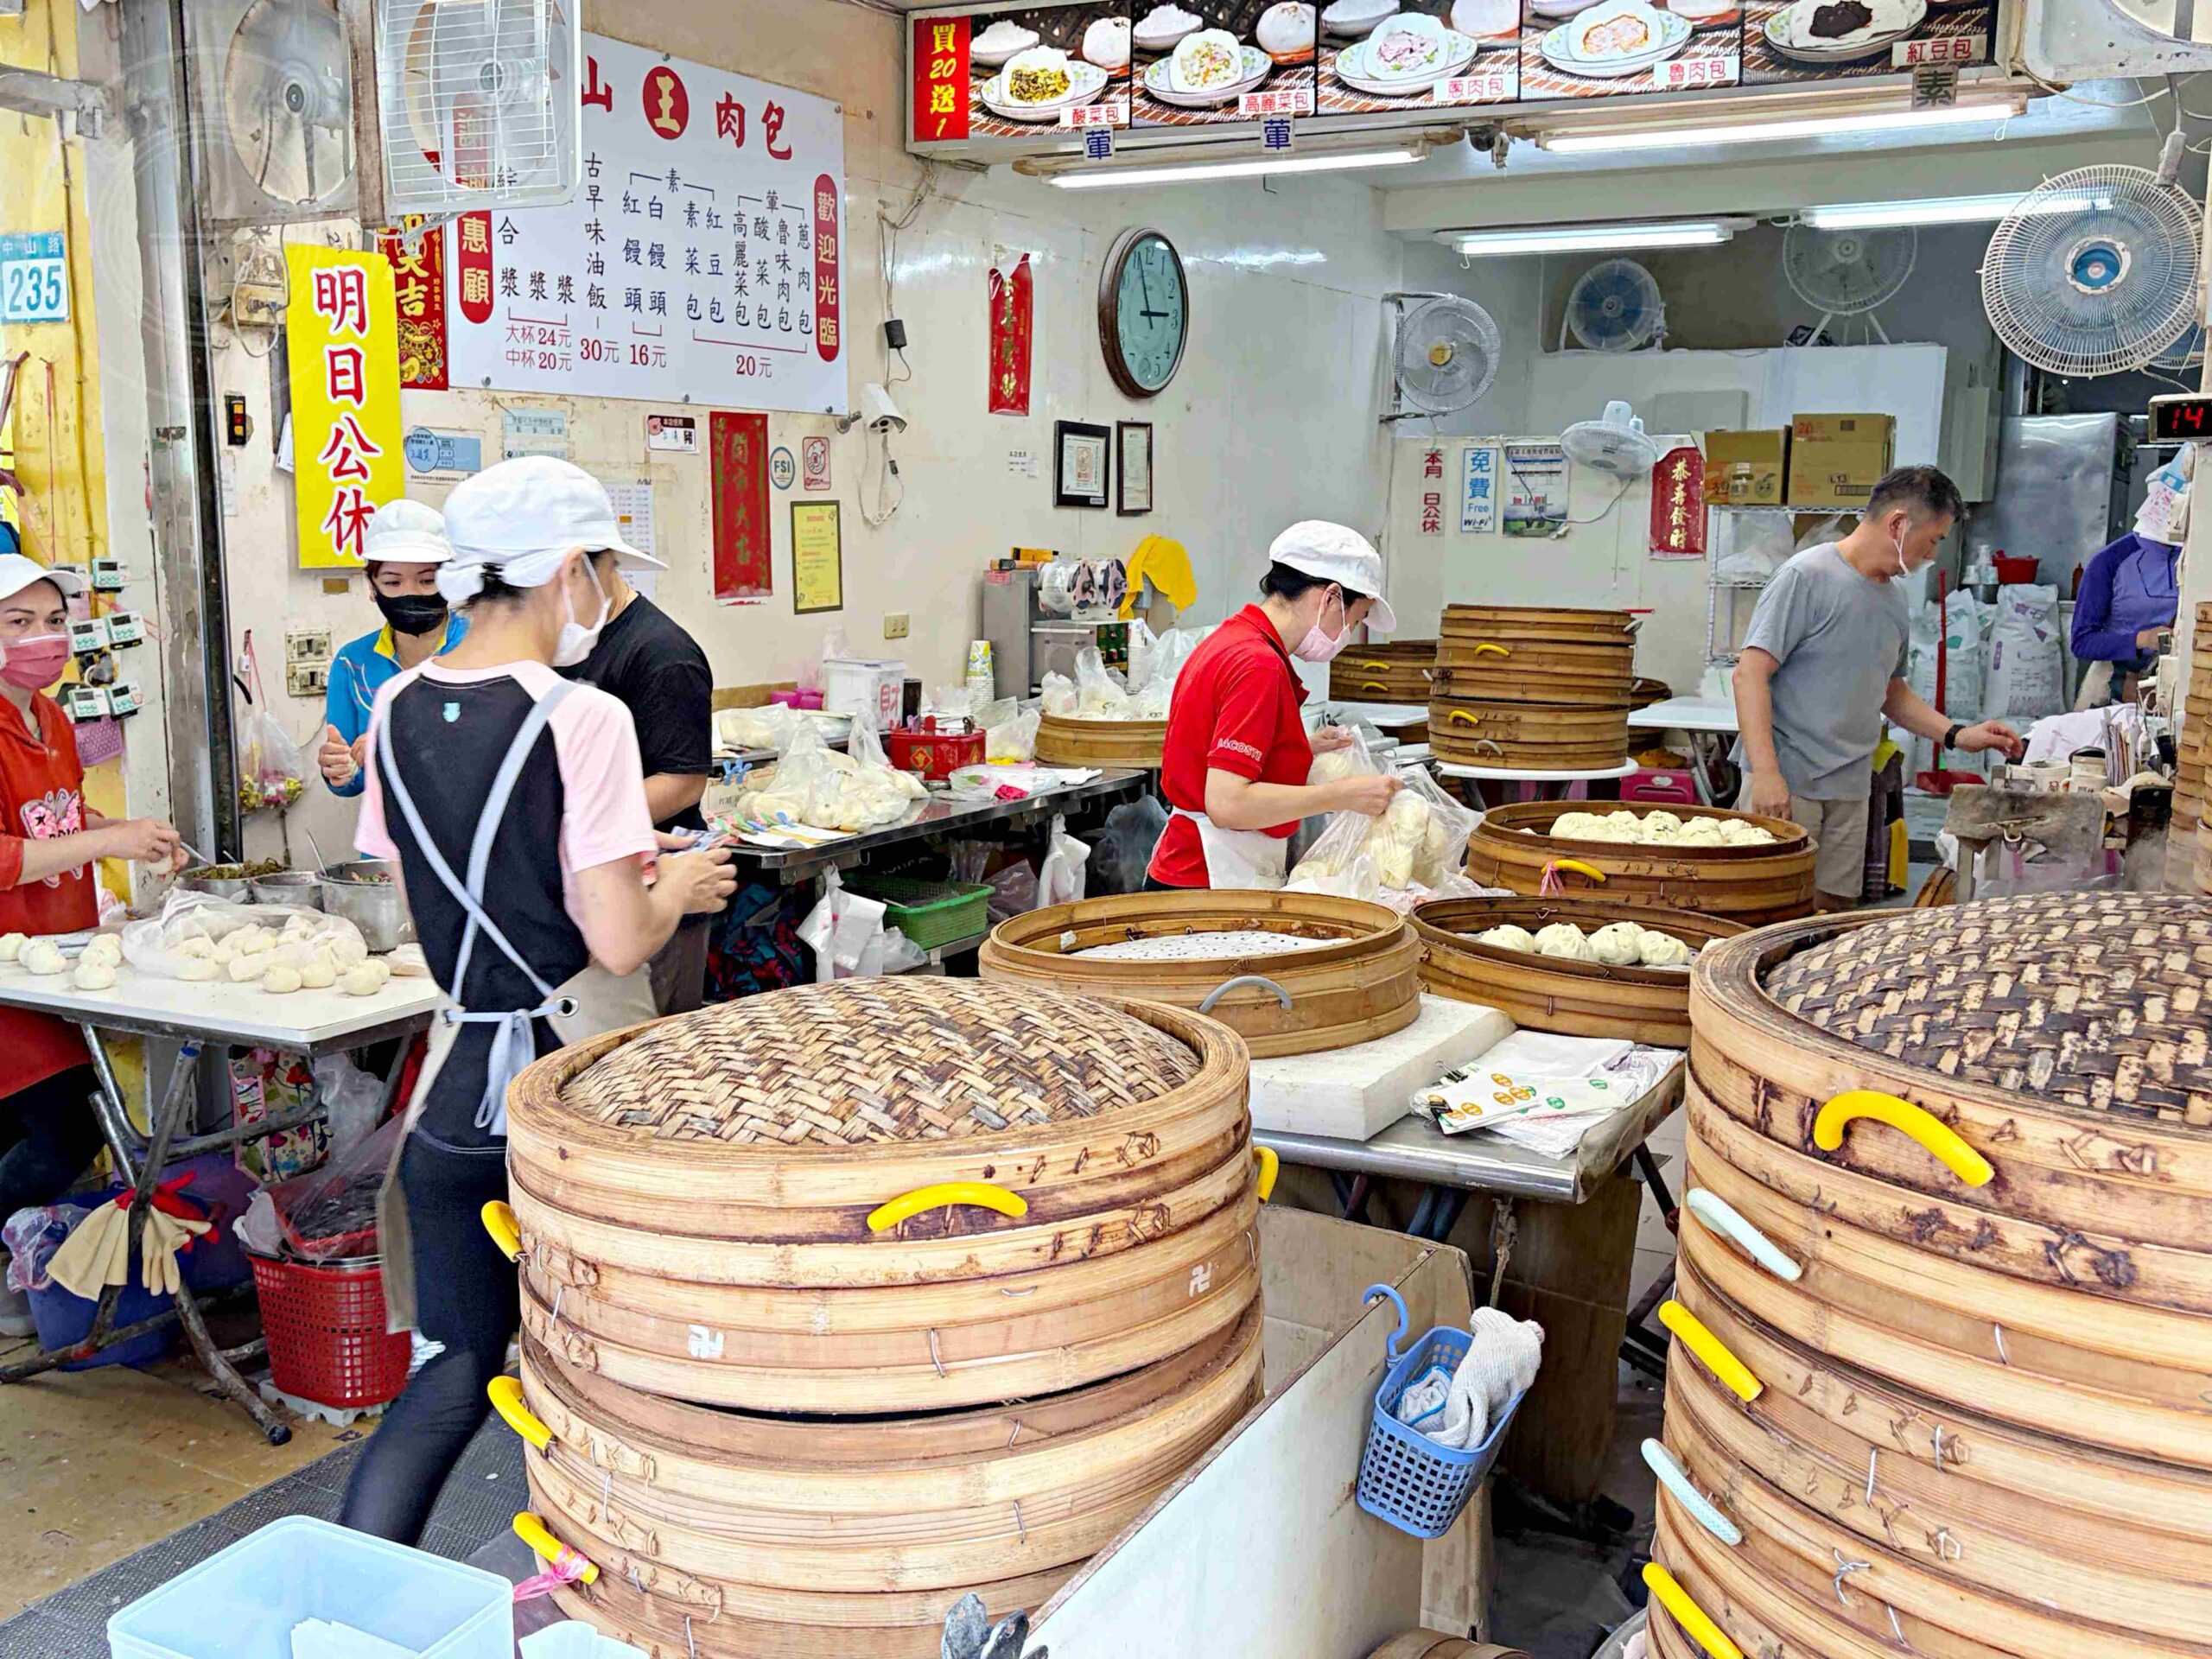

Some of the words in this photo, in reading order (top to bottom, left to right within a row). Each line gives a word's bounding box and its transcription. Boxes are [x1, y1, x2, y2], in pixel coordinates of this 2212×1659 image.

[1906, 38, 1973, 63] 紅豆包
[929, 22, 957, 137] 買20送1
[1668, 60, 1726, 84] 魯肉包
[1916, 69, 1954, 107] 素
[1071, 106, 1121, 126] 酸菜包
[1243, 92, 1309, 113] 高麗菜包
[1085, 129, 1113, 161] 葷
[1263, 118, 1292, 151] 葷
[665, 167, 681, 194] 素
[766, 188, 779, 213] 葷
[3, 237, 60, 257] 中山路
[583, 151, 608, 310] 古早味油飯
[622, 189, 644, 315] 紅饅頭
[646, 194, 668, 318] 白饅頭
[682, 200, 702, 321] 素菜包
[705, 207, 725, 324] 紅豆包
[732, 209, 751, 327] 高麗菜包
[817, 190, 838, 347] 歡迎光臨
[9, 264, 61, 313] 235
[753, 216, 772, 330] 酸菜包
[774, 217, 792, 333] 魯味肉包
[580, 337, 620, 365] 30元
[628, 342, 667, 370] 16元
[735, 353, 772, 378] 20元
[314, 267, 380, 558] 明日公休
[2171, 407, 2204, 430] 14
[773, 460, 791, 474] FSI
[1424, 450, 1443, 480] 本月
[1468, 450, 1491, 499] 免費
[1421, 492, 1441, 533] 日公休
[1467, 502, 1490, 513] Free
